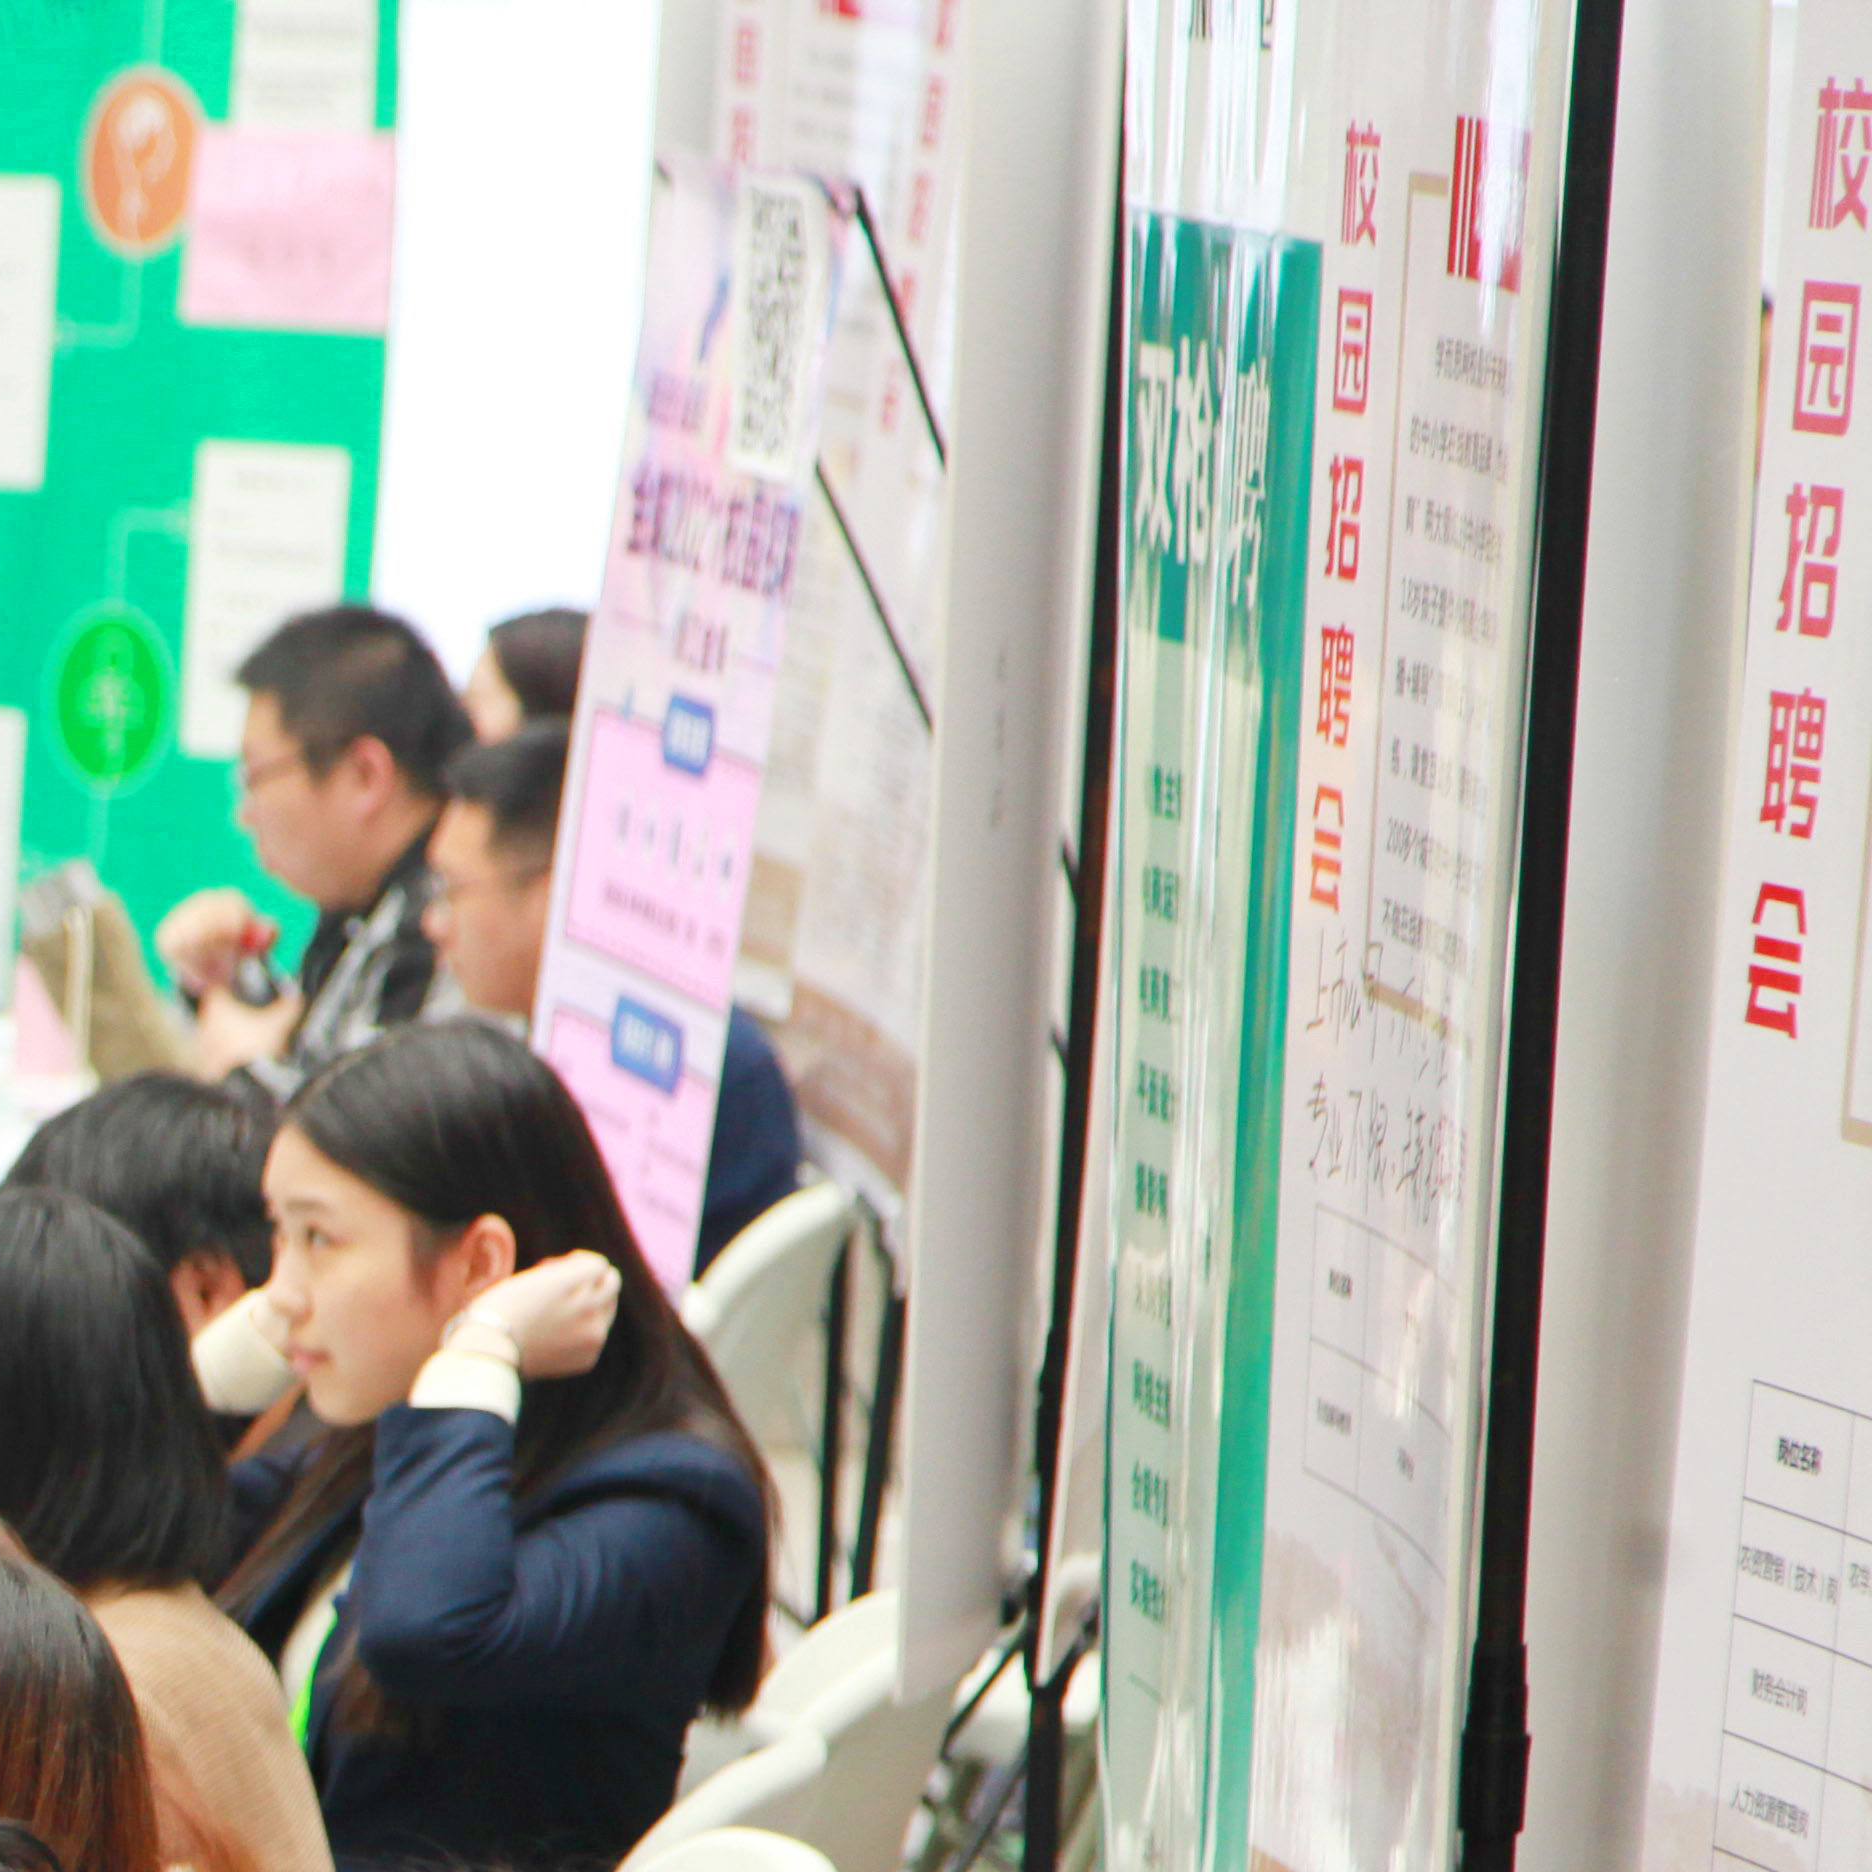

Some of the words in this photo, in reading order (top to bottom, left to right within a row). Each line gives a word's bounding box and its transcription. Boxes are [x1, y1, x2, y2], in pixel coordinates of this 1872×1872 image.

[1309, 119, 1381, 913] 校园招聘会
[1745, 76, 1872, 1039] 校园招聘会
